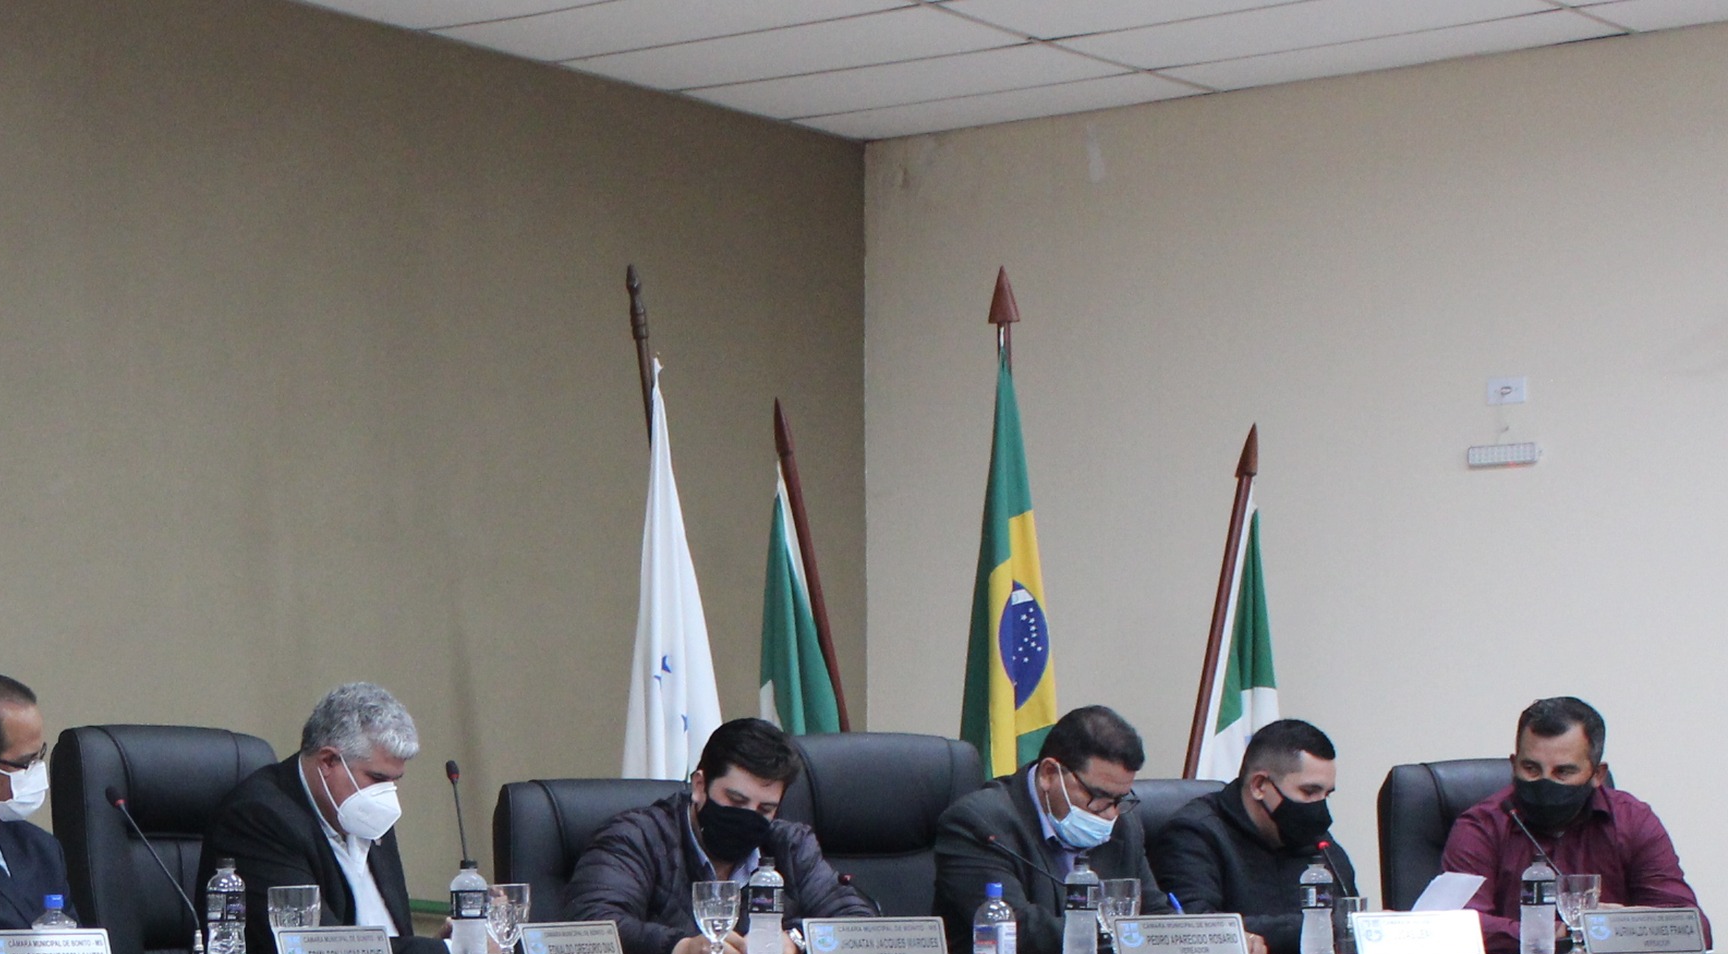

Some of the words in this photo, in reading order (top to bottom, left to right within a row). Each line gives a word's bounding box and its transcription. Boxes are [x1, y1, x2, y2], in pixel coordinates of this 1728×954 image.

[874, 937, 905, 948] JACQUES
[906, 936, 938, 948] MARQUES
[1146, 934, 1169, 945] PEDRO
[1170, 933, 1207, 945] APARECIDO
[1179, 946, 1209, 954] VEREADOR
